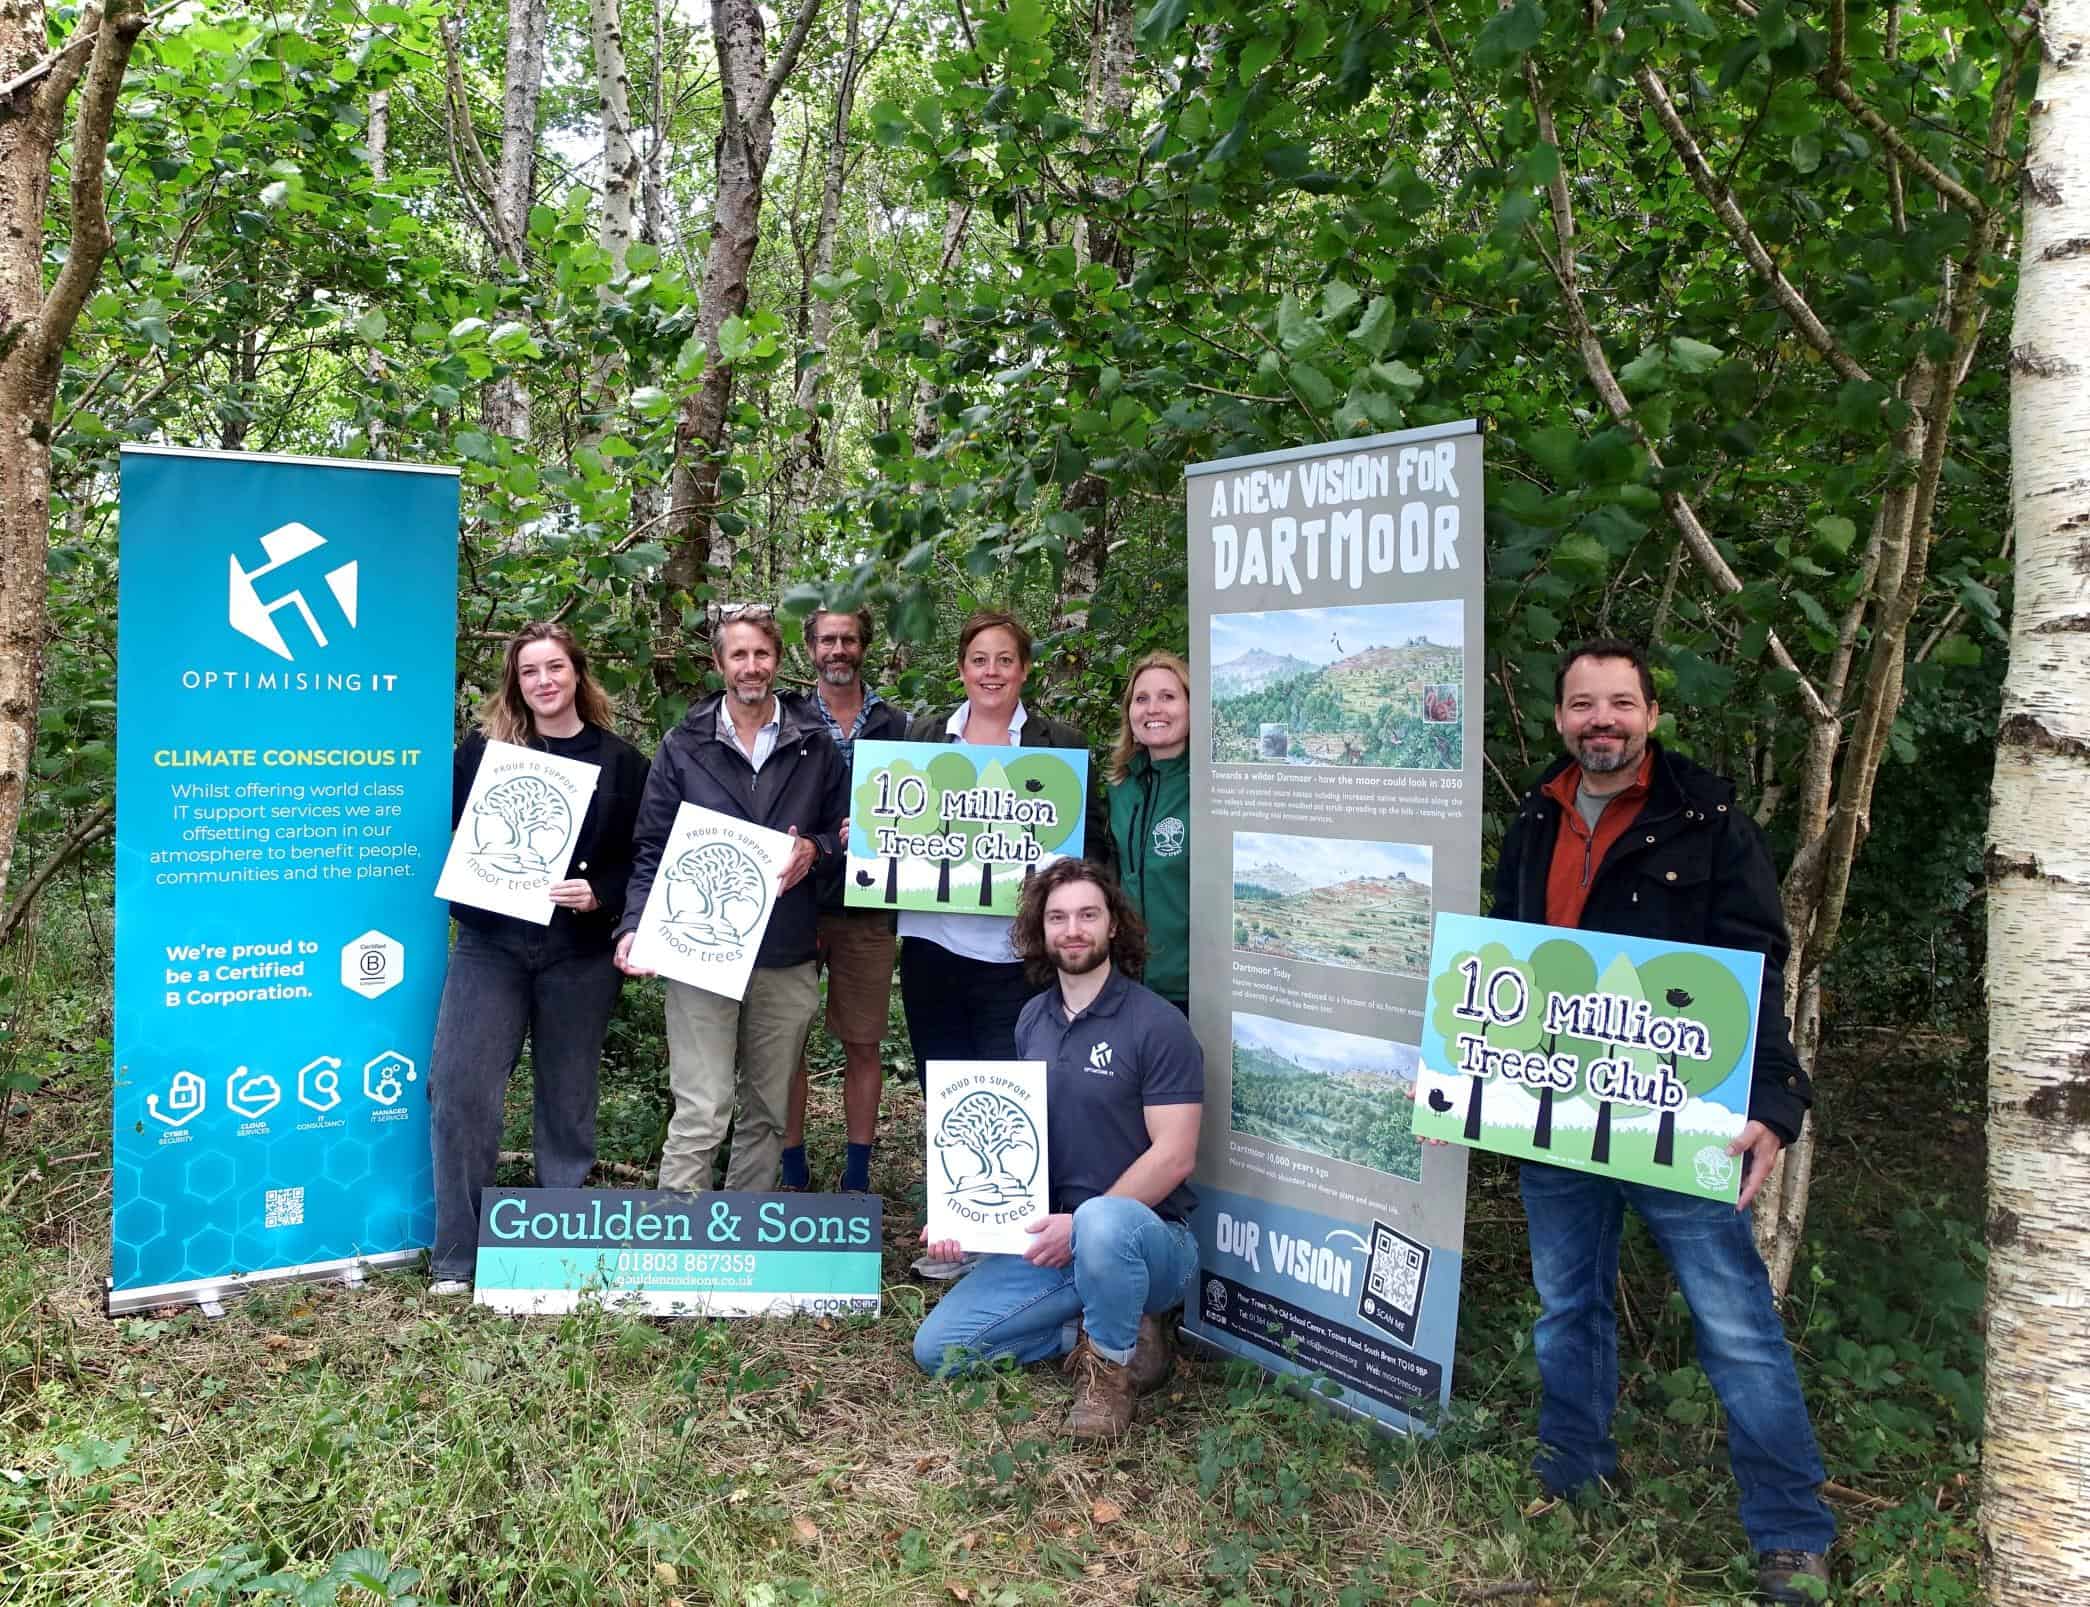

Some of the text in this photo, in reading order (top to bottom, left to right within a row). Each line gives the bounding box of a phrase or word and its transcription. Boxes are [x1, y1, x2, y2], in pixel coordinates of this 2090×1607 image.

[1210, 442, 1459, 518] A NEW VISION FOR
[1211, 502, 1460, 595] DARTMOOR
[182, 671, 398, 691] OPTIMISING IT
[154, 749, 421, 766] CLIMATE CONSCIOUS IT
[493, 761, 579, 795] PROUD TO SUPPORT
[1318, 776, 1337, 784] how
[1338, 776, 1353, 785] the
[1383, 777, 1407, 787] could
[1408, 778, 1427, 787] look
[1429, 779, 1438, 788] in
[1440, 779, 1463, 789] 2050
[171, 782, 405, 800] Whilst offering world class
[874, 773, 1056, 824] 10 Million
[173, 804, 402, 823] IT support services we are
[183, 823, 392, 842] offsetting carbon in our
[150, 843, 421, 865] atmosphere to benefit people,
[685, 827, 774, 866] PROUD TO SUPPORT
[975, 834, 1042, 863] Club
[156, 863, 415, 885] communities and the planet.
[466, 857, 551, 891] moor trees
[166, 940, 318, 961] We're proud to
[657, 925, 745, 963] moor trees
[166, 961, 304, 984] be a Certified
[367, 955, 379, 970] B
[1232, 961, 1292, 981] Dartmoor Today
[166, 984, 312, 1007] B Corporation.
[1456, 960, 1711, 1056] 10 Million
[940, 1075, 1032, 1101] PROUD TO SUPPORT
[1589, 1062, 1685, 1108] Club
[1267, 1151, 1290, 1167] 10,000
[1291, 1160, 1314, 1174] years
[489, 1198, 872, 1245] Goulden & Sons
[946, 1197, 1036, 1225] moor trees
[618, 1252, 756, 1274] 01803 867359
[1216, 1212, 1352, 1297] OUR VISION
[1376, 1308, 1394, 1326] SCAN
[1363, 1343, 1380, 1358] South
